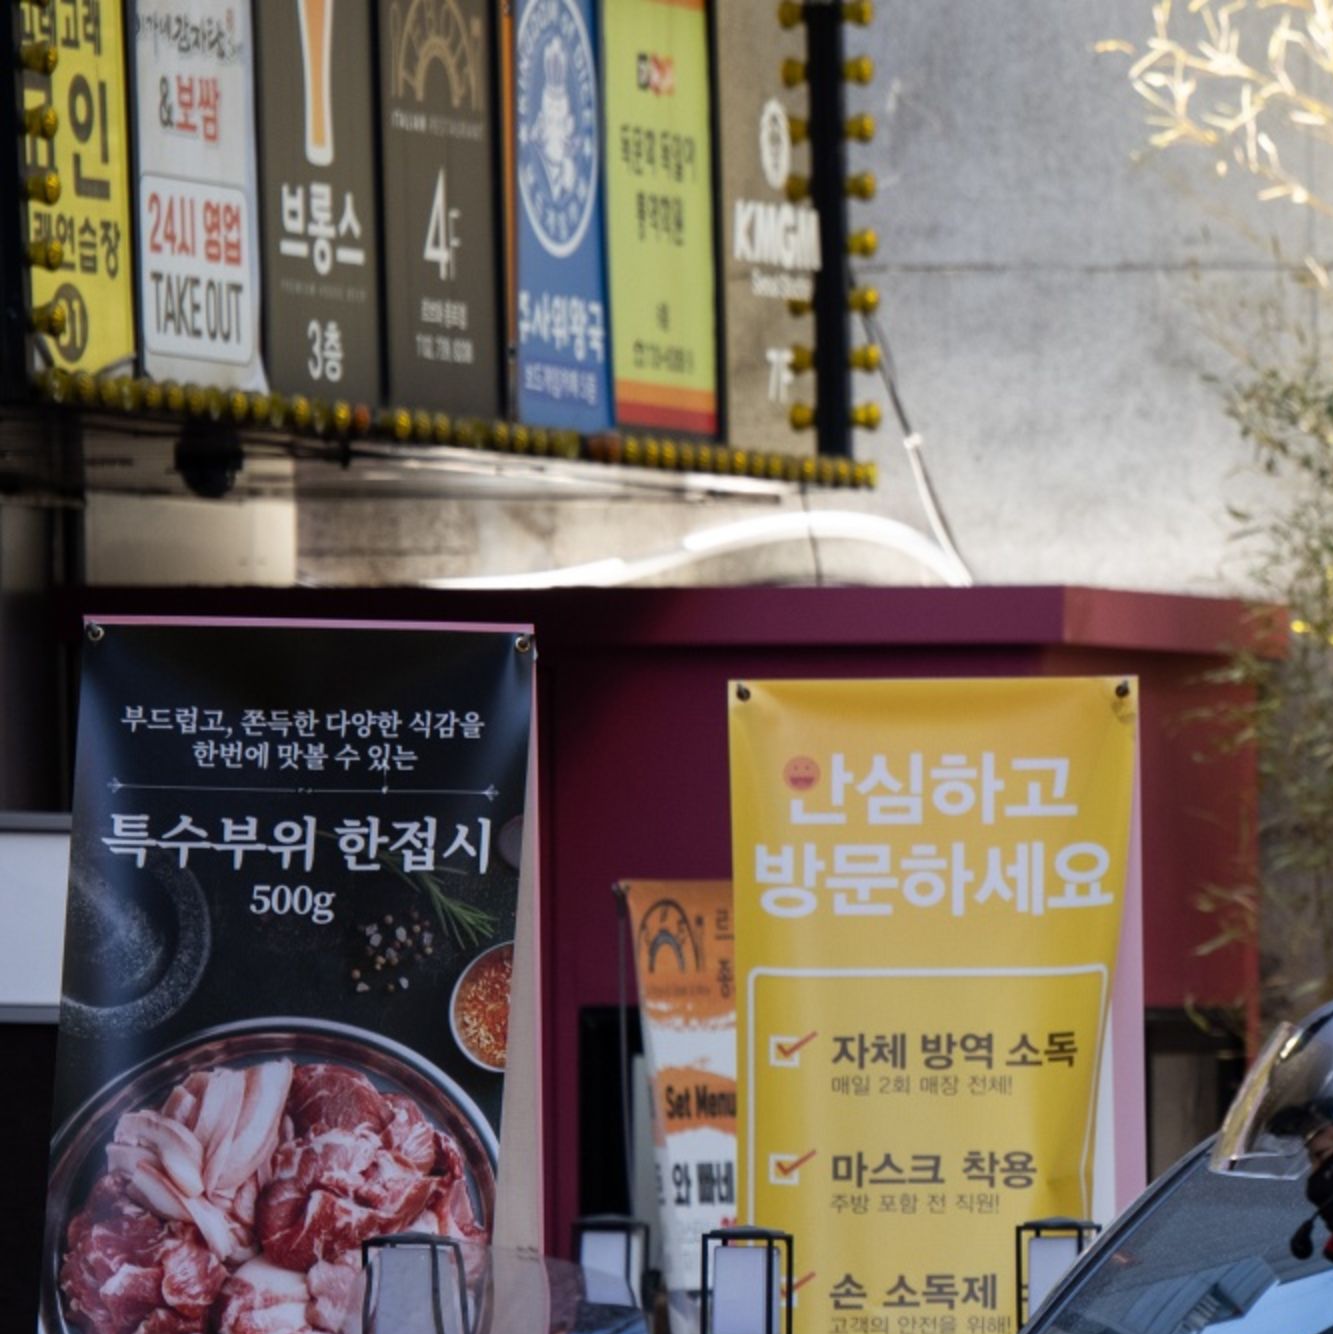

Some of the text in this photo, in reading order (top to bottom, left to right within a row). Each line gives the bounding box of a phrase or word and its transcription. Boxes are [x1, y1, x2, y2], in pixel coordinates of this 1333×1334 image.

[148, 191, 243, 267] 24시 영업
[280, 181, 366, 276] 브롱스
[151, 271, 244, 345] TAKE OUT
[307, 319, 344, 383] 3층
[121, 705, 486, 740] 부드럽고, 쫀득한 다양한 식감을
[192, 741, 418, 771] 한번에 맛볼 수 있는
[783, 752, 1078, 825] 안심하고
[101, 814, 492, 875] 특수부위 한접시
[754, 841, 1114, 918] 방문하세요
[249, 884, 336, 925] 500g
[831, 1031, 1078, 1070] 자체 방역 소독
[831, 1074, 1013, 1097] 매일 2회 매장 전체!
[832, 1150, 1038, 1190] 마스크 착용
[830, 1192, 1001, 1216] 주방 포함 전 직원!
[829, 1273, 869, 1311] 손
[882, 1272, 999, 1310] 소독제
